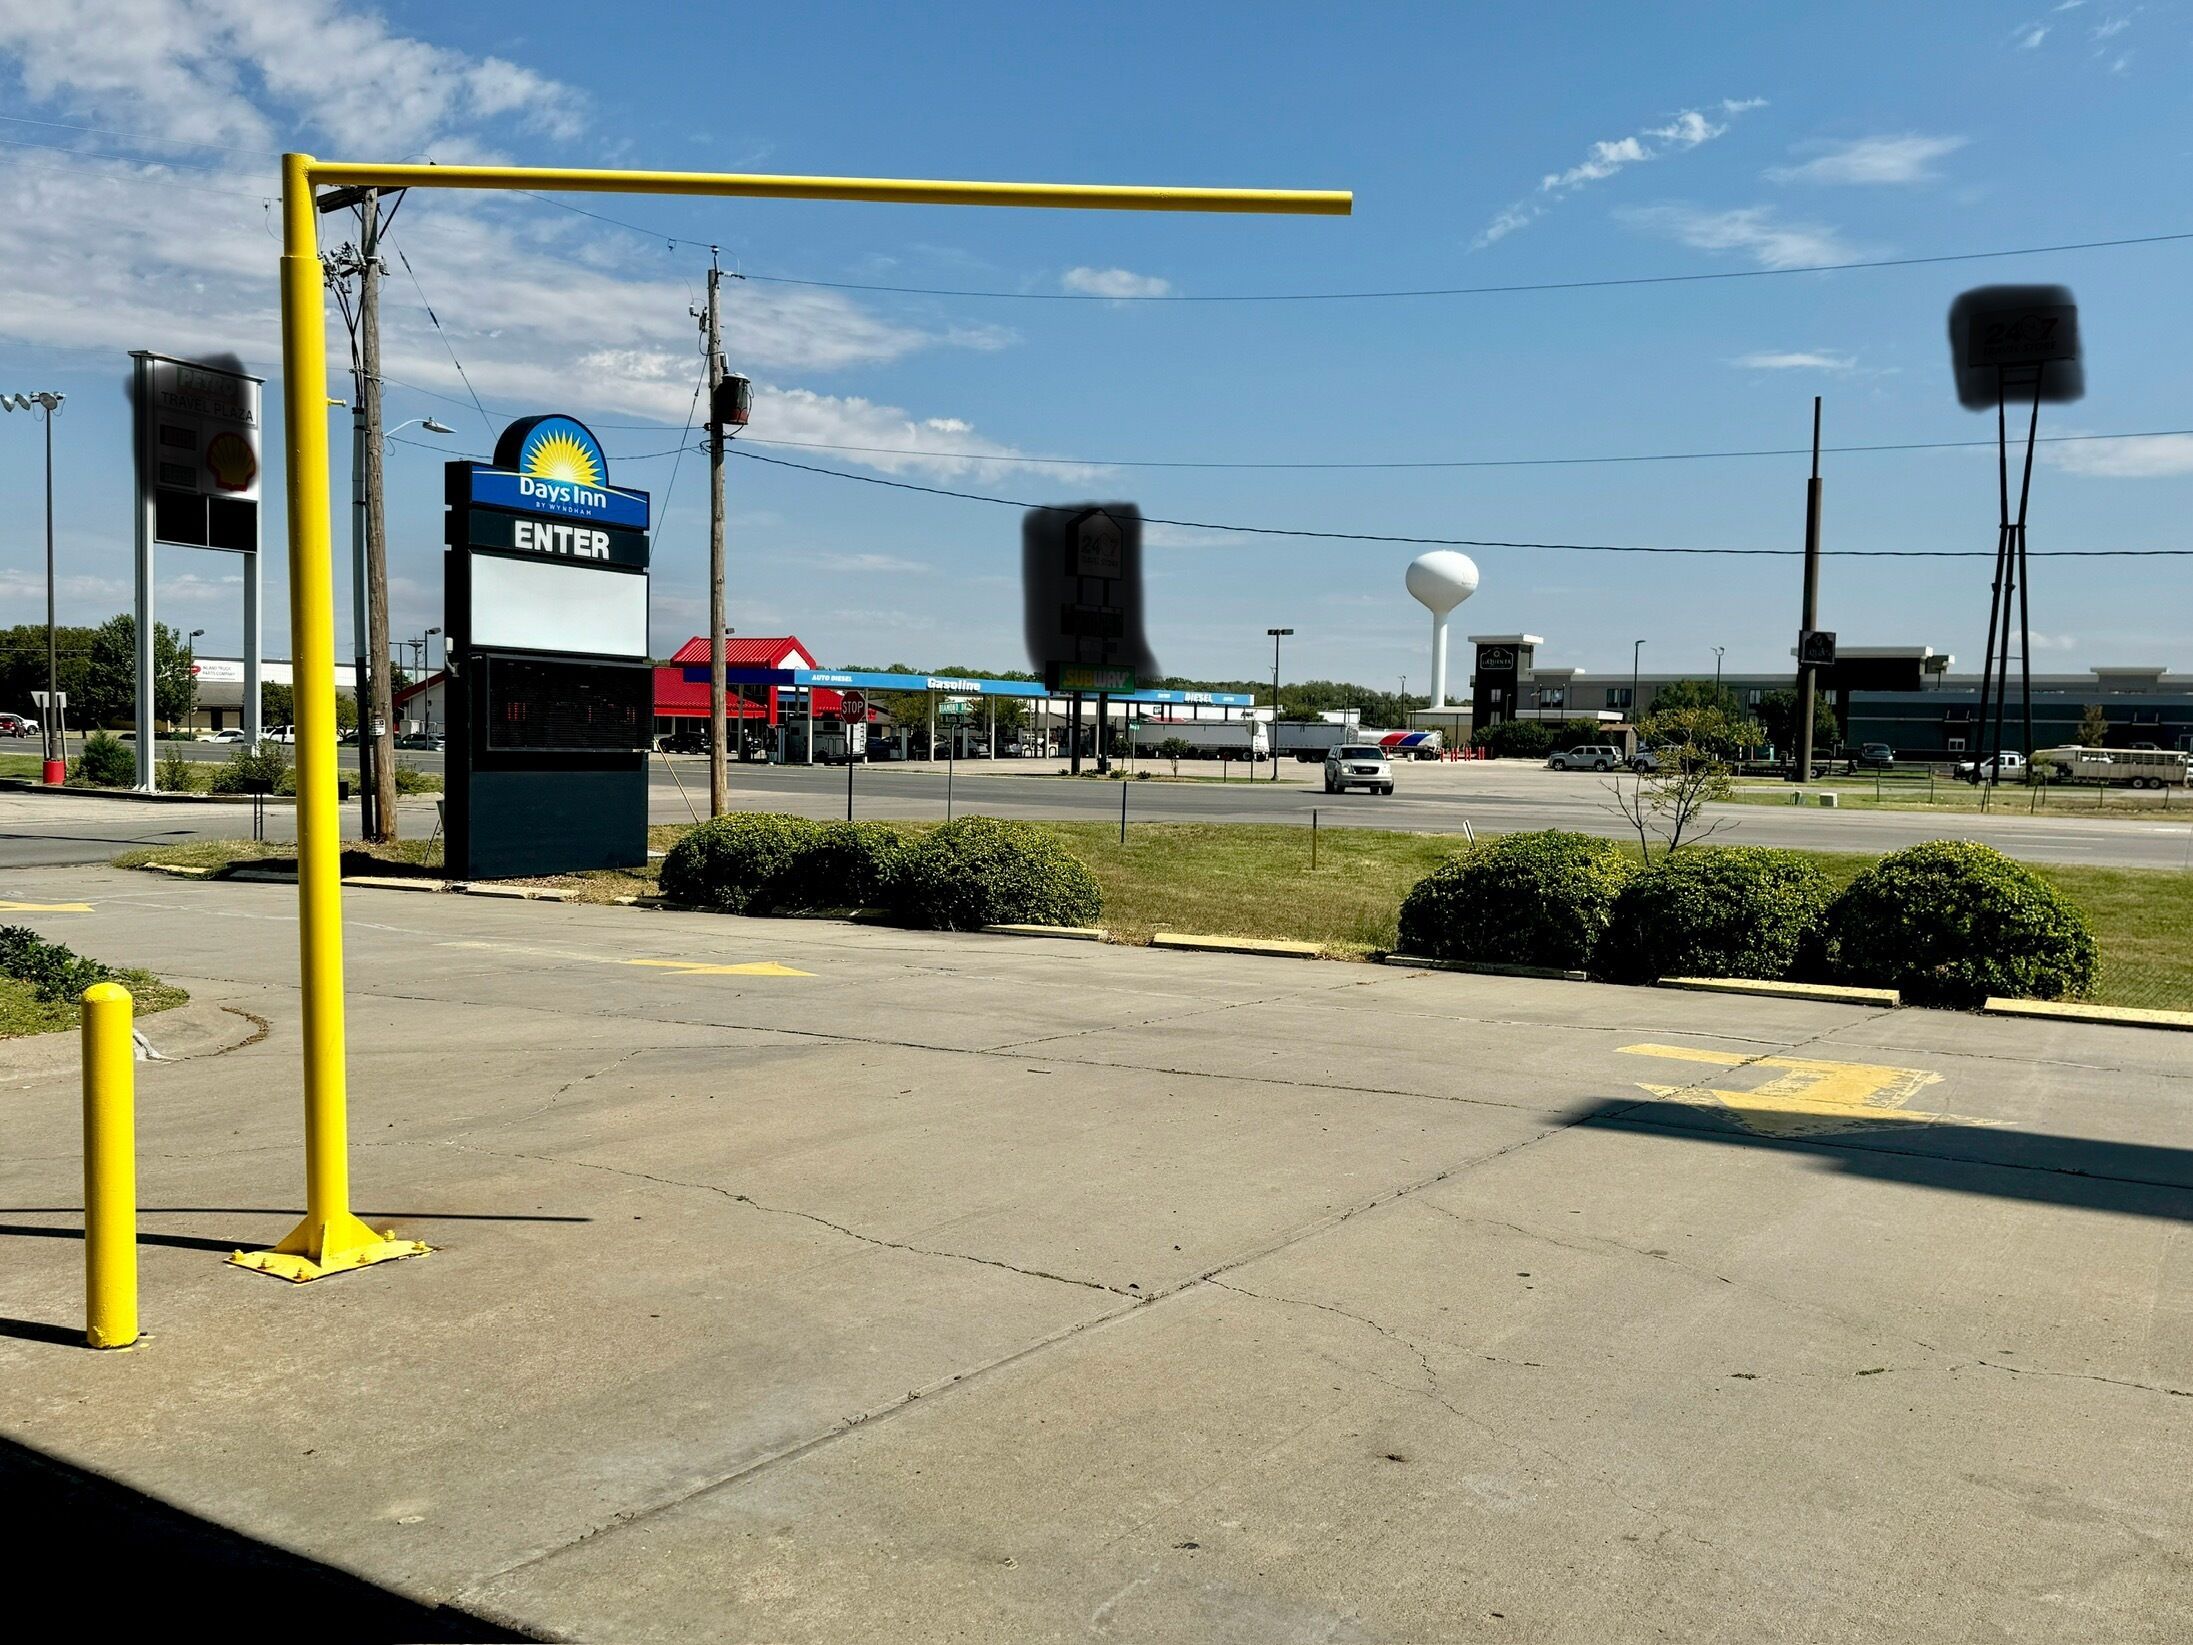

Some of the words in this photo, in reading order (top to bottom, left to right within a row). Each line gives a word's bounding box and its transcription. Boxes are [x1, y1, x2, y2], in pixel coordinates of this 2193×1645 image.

[161, 392, 209, 413] TRAVEL
[214, 403, 253, 421] PLAZA
[520, 476, 571, 502] Days
[573, 485, 606, 509] Inn
[536, 501, 546, 509] BY
[549, 503, 592, 516] WYNDHAM
[515, 520, 609, 561] ENTER
[811, 674, 830, 682] AUTO
[831, 675, 853, 683] DIESEL
[927, 678, 981, 692] Gasoline
[1063, 670, 1128, 690] SUBWAY
[1184, 692, 1213, 703] DIESEL
[842, 701, 864, 714] STOP
